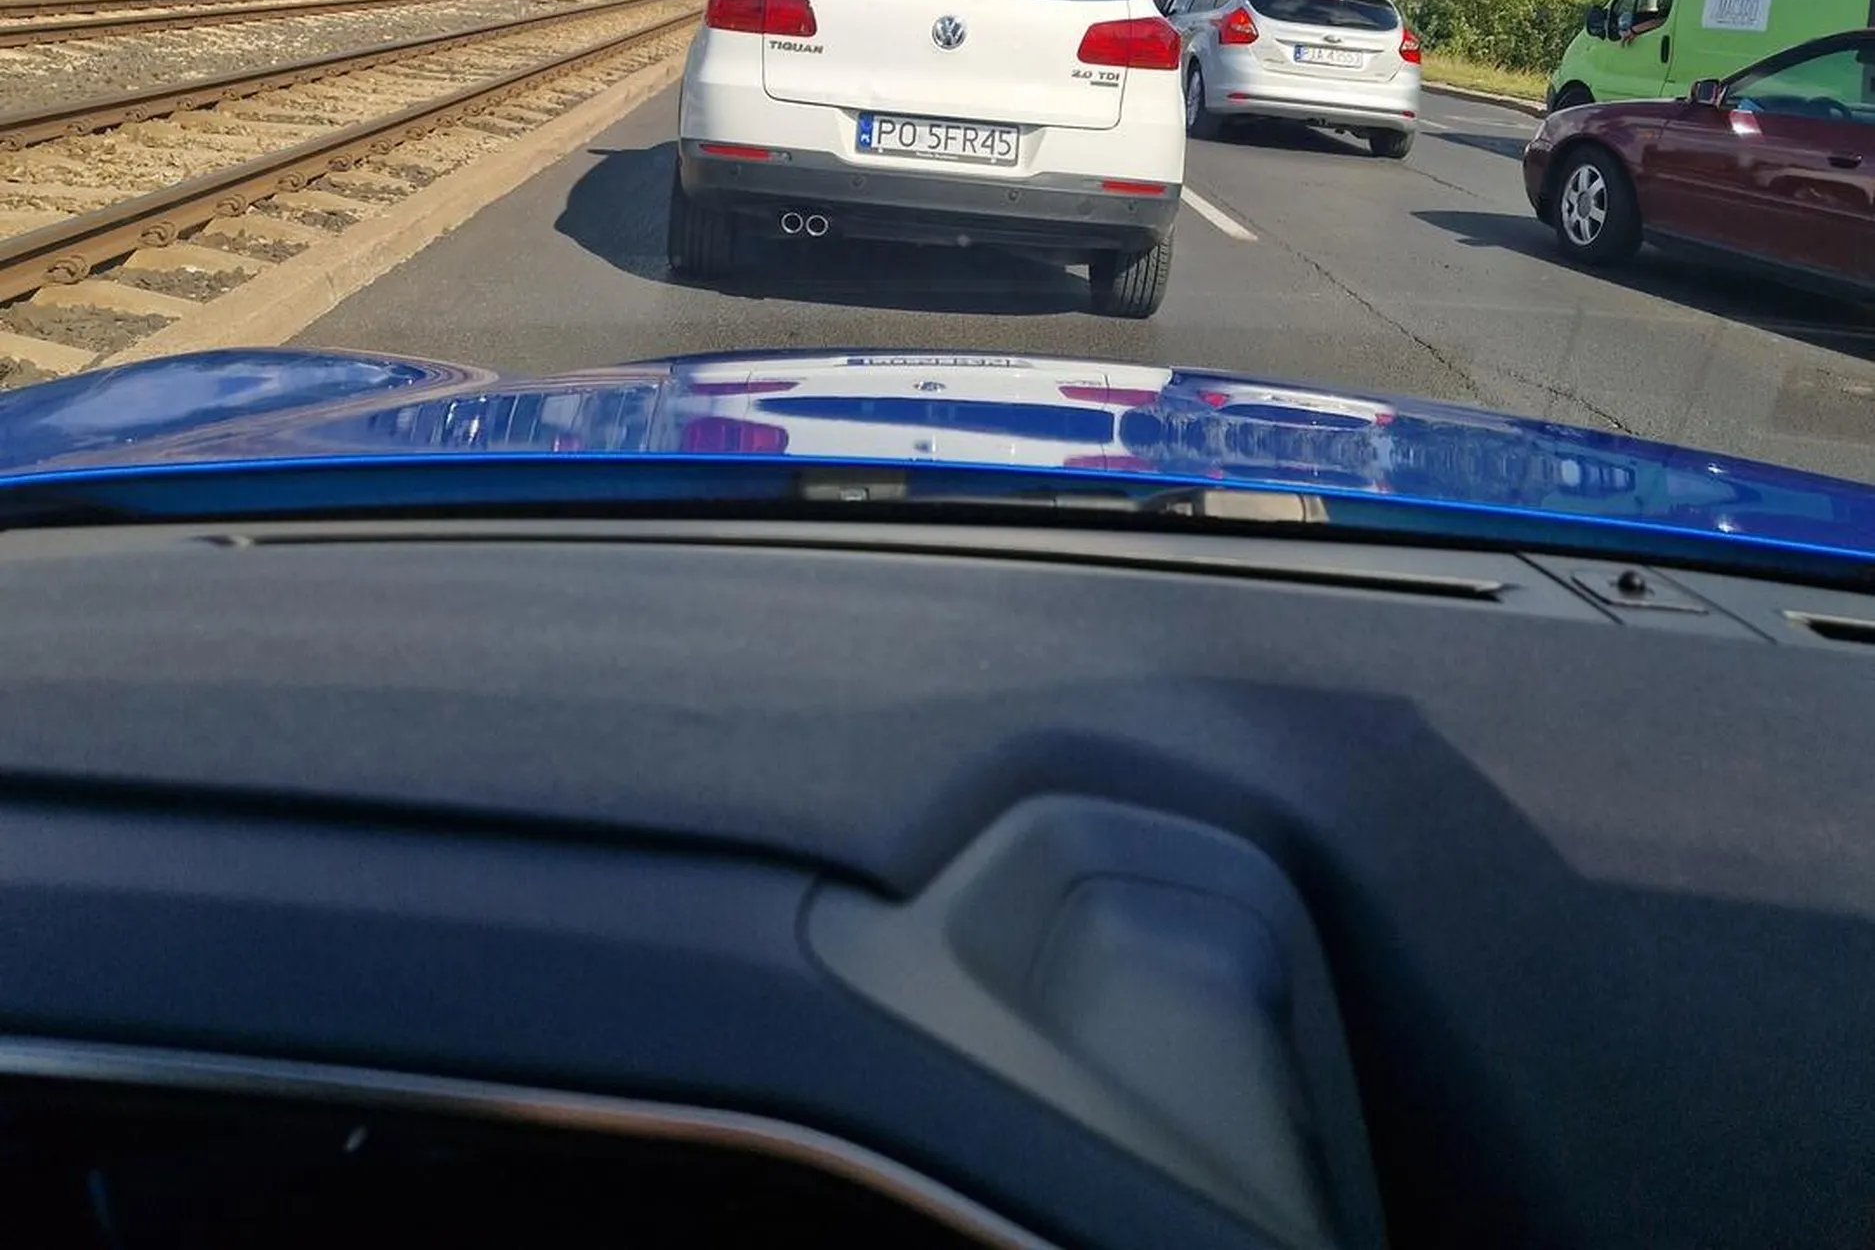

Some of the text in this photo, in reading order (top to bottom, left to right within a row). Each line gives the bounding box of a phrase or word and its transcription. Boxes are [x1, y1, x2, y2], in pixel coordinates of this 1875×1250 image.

[769, 40, 823, 54] TIGUAN
[1071, 68, 1120, 81] 2.0 TDI
[877, 118, 1012, 157] PO 5FR45
